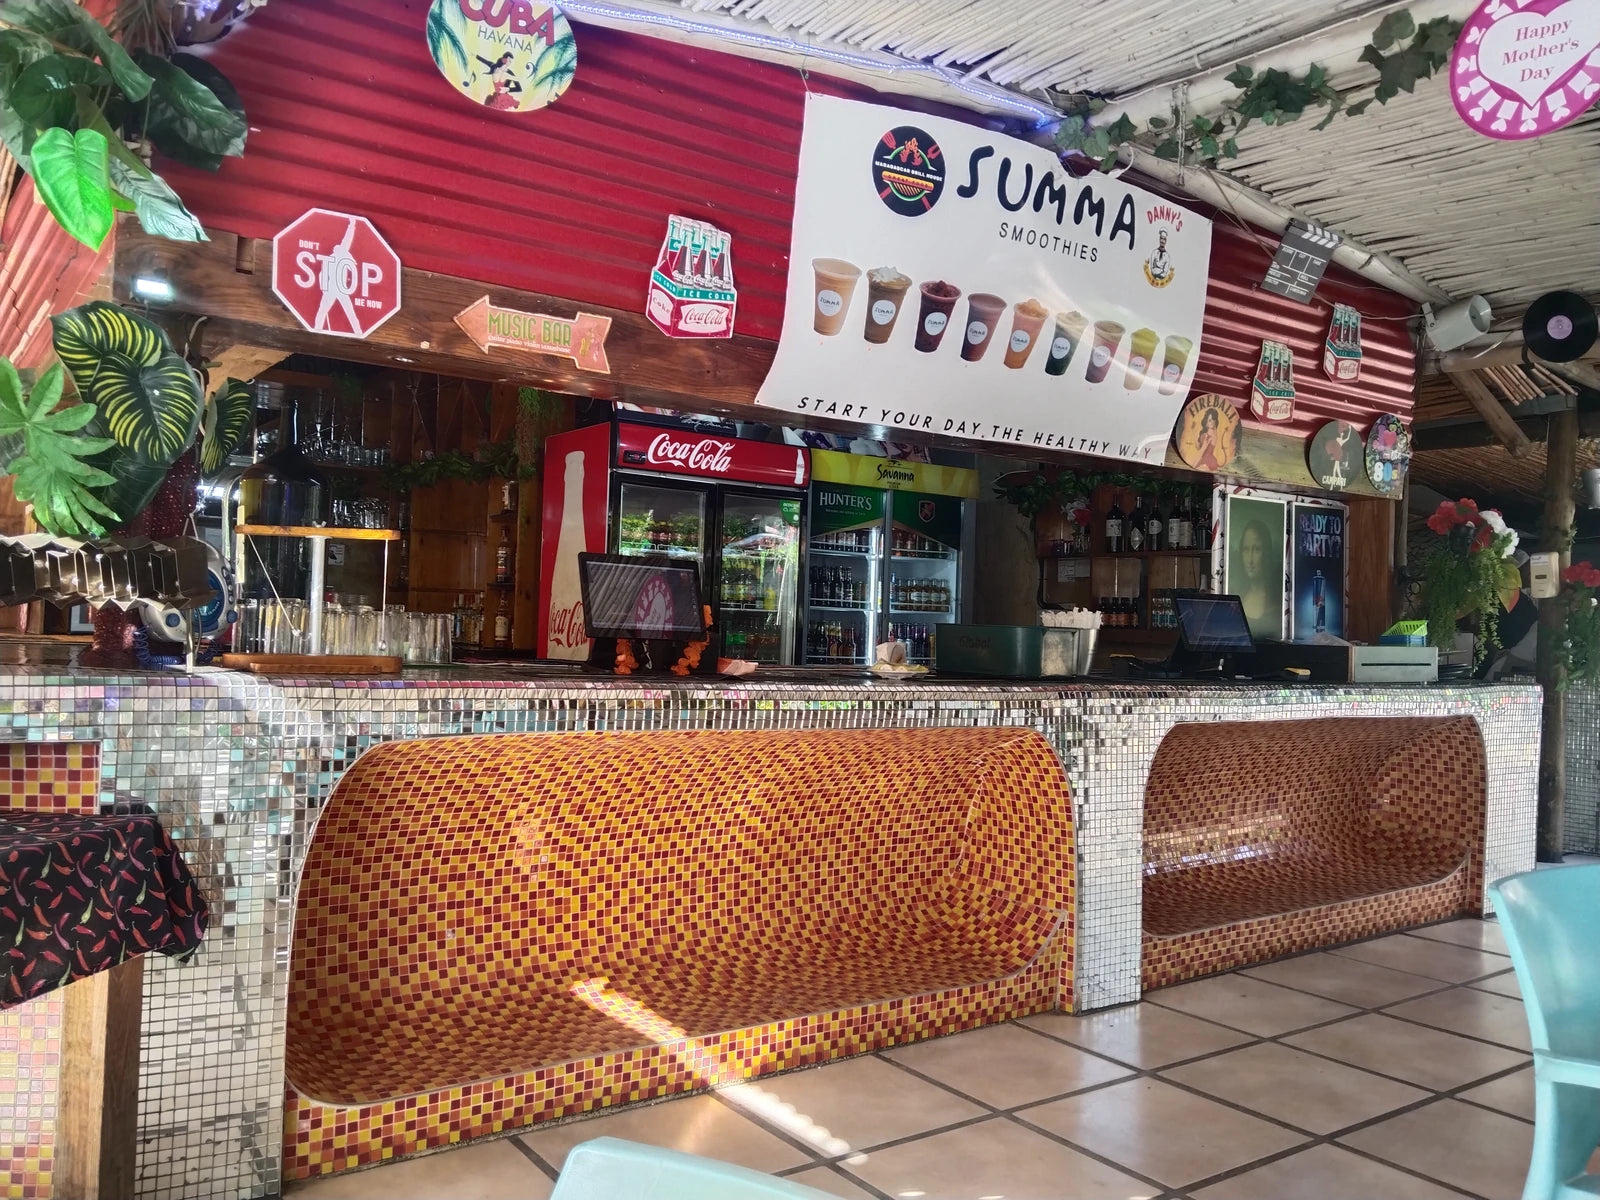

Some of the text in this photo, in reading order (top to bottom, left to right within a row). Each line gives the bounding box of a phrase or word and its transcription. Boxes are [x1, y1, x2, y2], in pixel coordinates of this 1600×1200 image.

[459, 0, 555, 46] CUBA
[1516, 20, 1571, 41] Happy
[478, 26, 533, 54] HAVANA
[1503, 39, 1579, 65] Mother's
[1520, 66, 1553, 82] Day
[956, 145, 1136, 250] SUMMA
[1147, 205, 1182, 232] DANNY'S
[298, 239, 320, 251] DON'T
[999, 222, 1098, 262] SMOOTHIES
[294, 250, 383, 297] STOP
[354, 297, 383, 310] ME NOW
[682, 290, 732, 301] ICE COLD
[487, 312, 572, 346] MUSIC BAR
[684, 308, 725, 326] Coca-Cola
[1189, 394, 1237, 424] FIREBALL
[797, 396, 868, 419] START
[880, 409, 932, 428] YOUR
[991, 425, 1023, 442] THE
[1033, 432, 1110, 454] HEALTHY
[648, 433, 735, 473] Coca-Cola
[876, 464, 915, 483] Savanna
[1322, 475, 1347, 487] CAMPARI
[819, 491, 872, 511] HUNTER'S
[1300, 513, 1342, 535] READY TO
